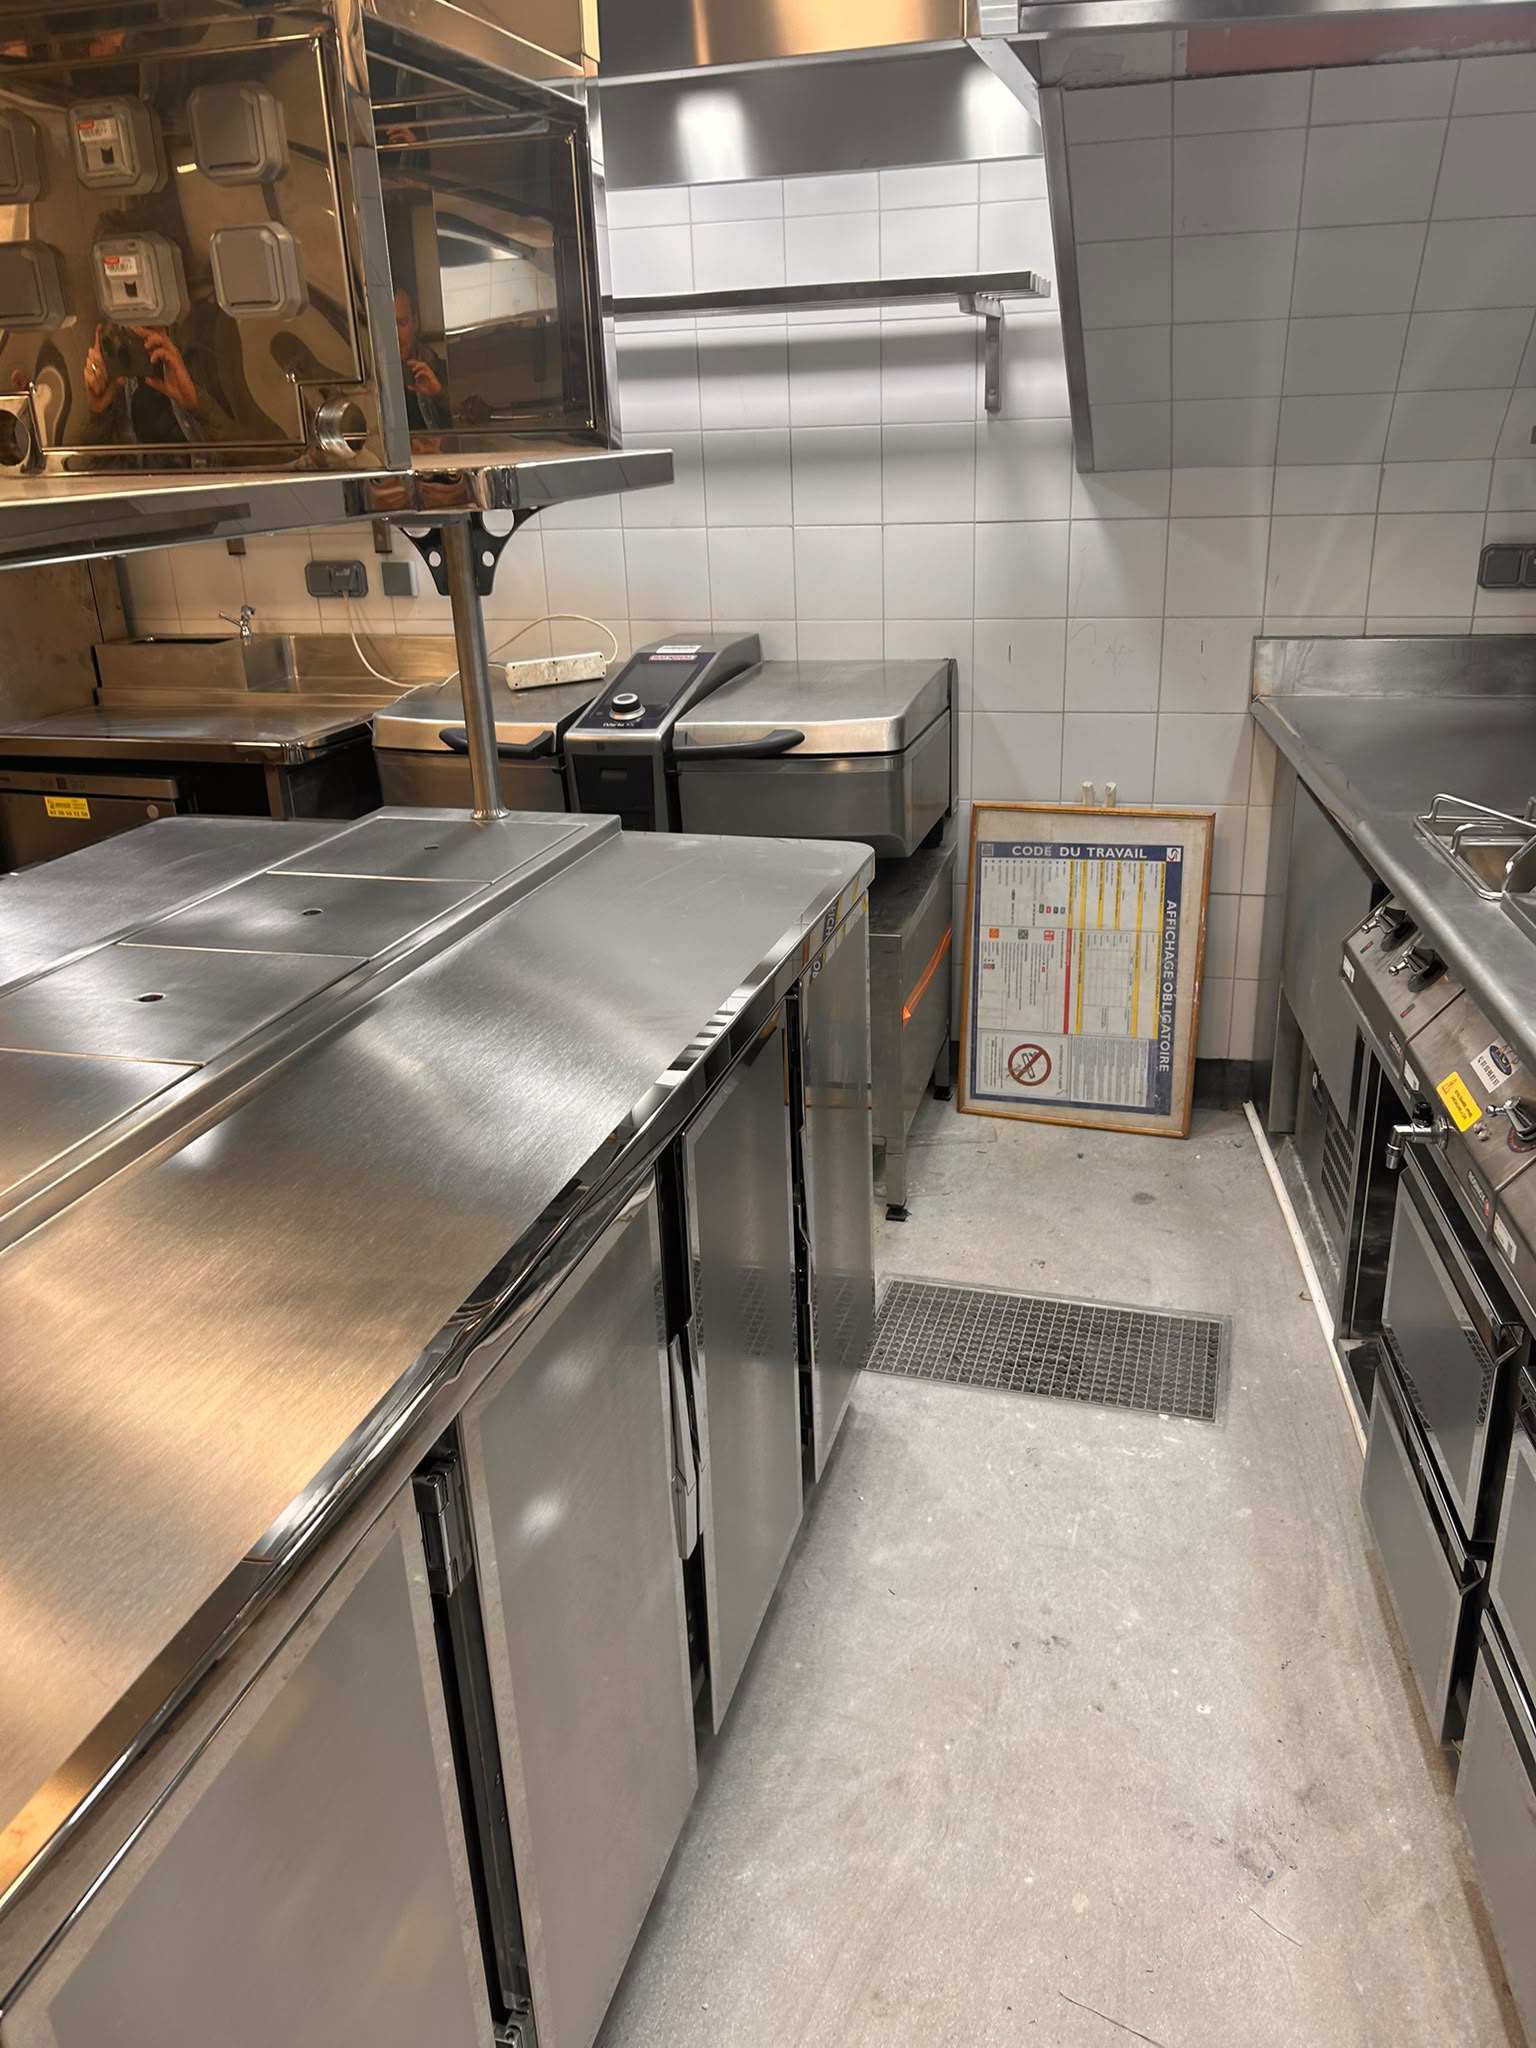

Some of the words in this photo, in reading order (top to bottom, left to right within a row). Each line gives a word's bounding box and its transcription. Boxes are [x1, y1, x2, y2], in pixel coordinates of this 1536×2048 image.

[1012, 845, 1052, 857] CODE
[1060, 846, 1081, 858] DU
[1087, 847, 1148, 860] TRAVAIL
[1163, 900, 1177, 979] AFFICHAGE
[1159, 981, 1173, 1072] OBLIGATOIRE
